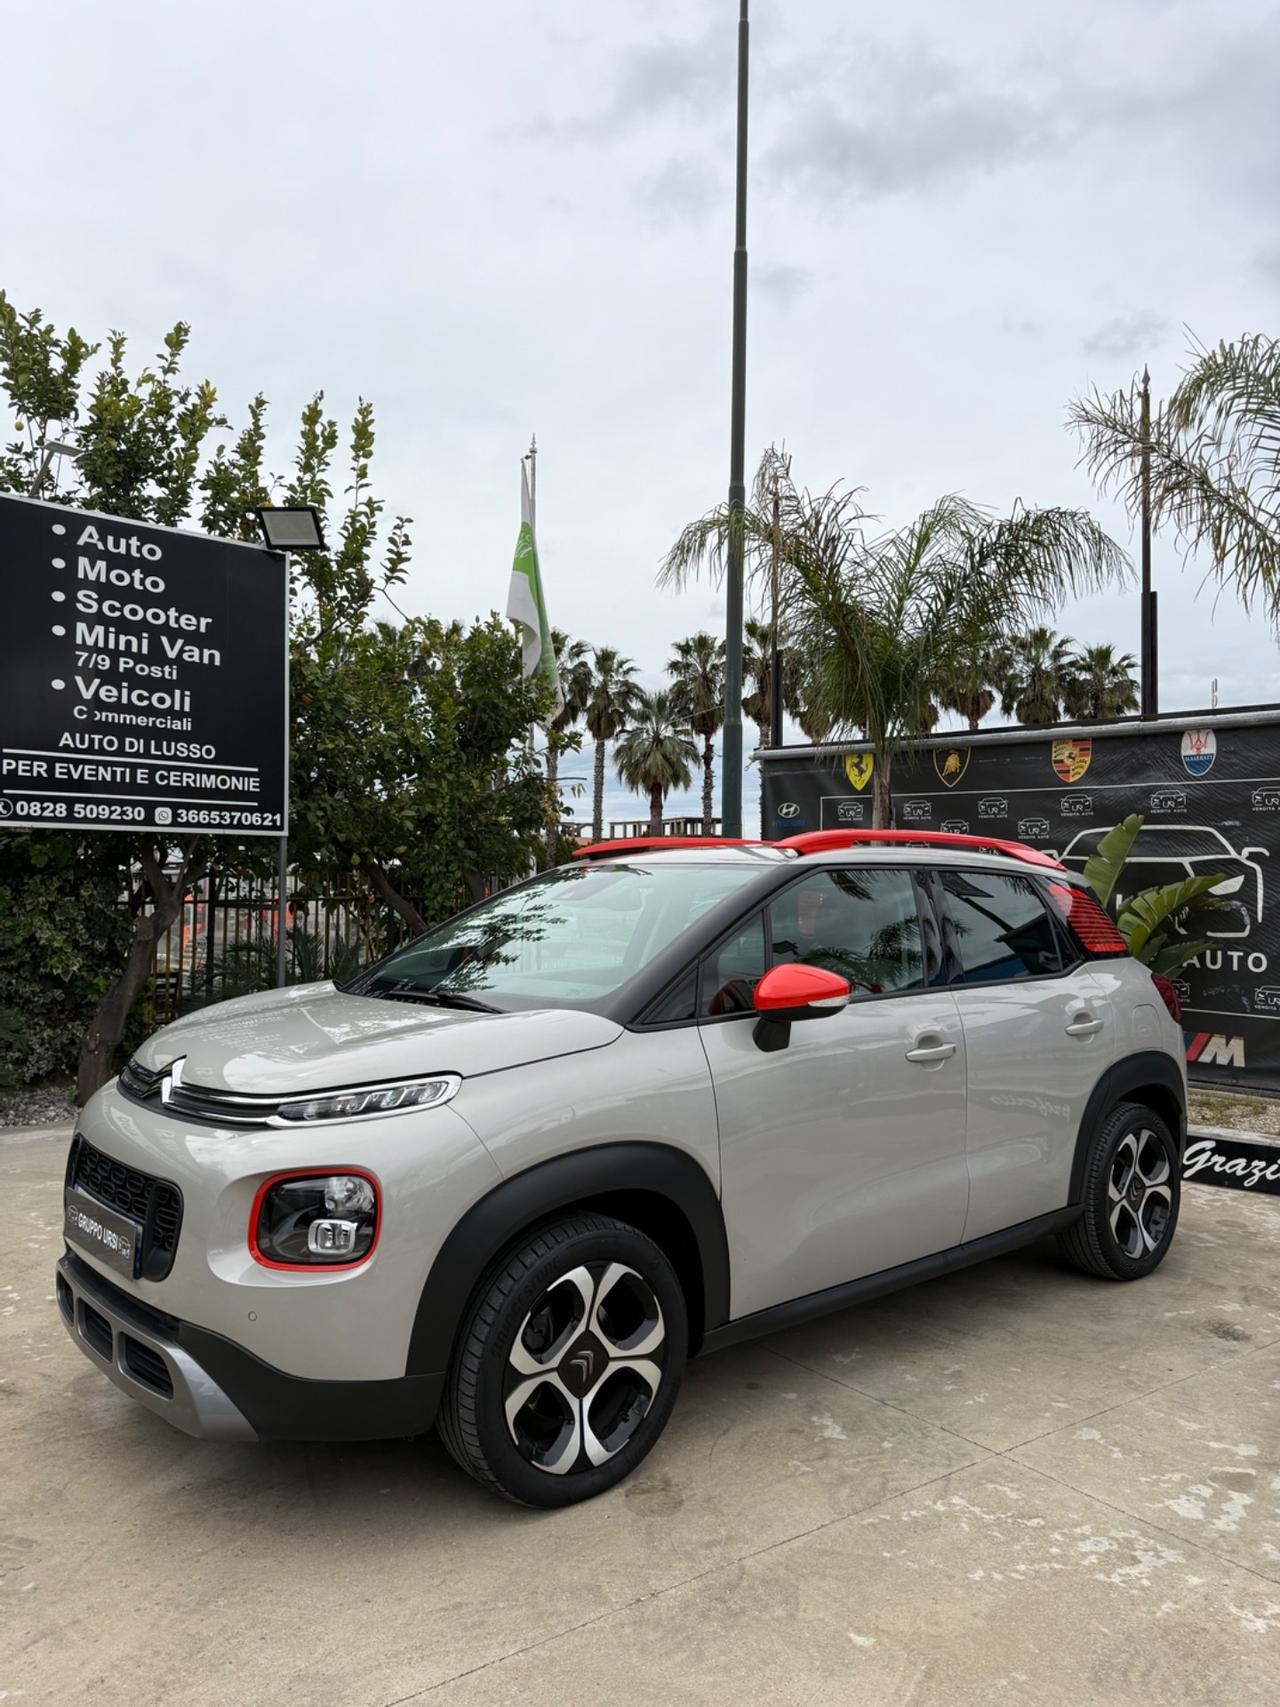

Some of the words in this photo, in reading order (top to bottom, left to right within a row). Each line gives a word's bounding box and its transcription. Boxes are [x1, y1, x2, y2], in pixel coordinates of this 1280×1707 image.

[77, 525, 162, 561] Auto
[77, 555, 166, 593] Moto
[75, 589, 213, 633] Scooter
[75, 621, 149, 655] Mini
[160, 635, 221, 666] Van
[74, 650, 111, 670] 7/9
[118, 657, 178, 680] Posti
[74, 675, 191, 712] Veicoli
[58, 731, 119, 751] AUTO
[124, 737, 144, 754] DI
[150, 739, 216, 760] LUSSO
[2, 758, 48, 778] PER
[54, 762, 130, 783] EVENTI
[136, 768, 149, 784] E
[155, 770, 260, 792] CERIMONIE
[15, 800, 67, 818] 0828
[73, 803, 145, 821] 509230
[177, 809, 281, 826] 3665370621
[1182, 949, 1268, 973] AUTO
